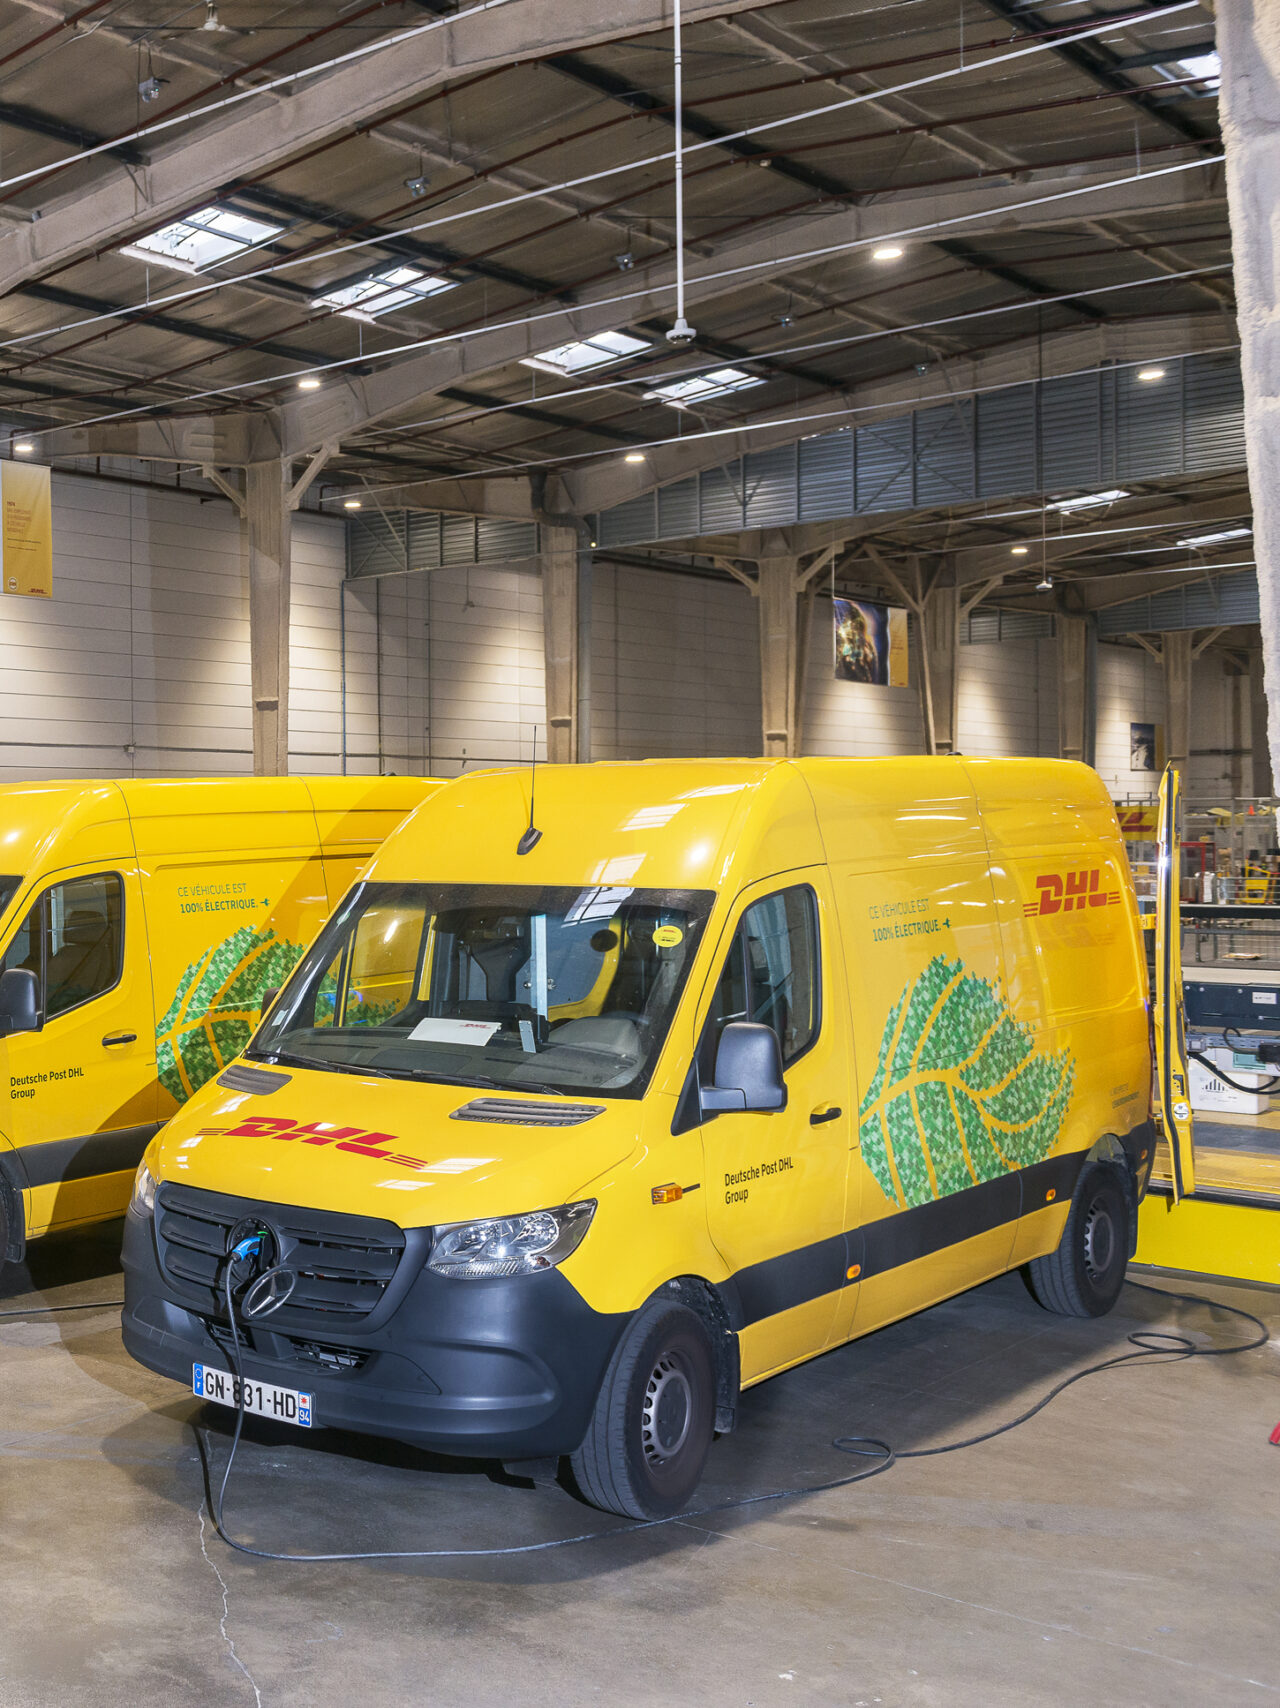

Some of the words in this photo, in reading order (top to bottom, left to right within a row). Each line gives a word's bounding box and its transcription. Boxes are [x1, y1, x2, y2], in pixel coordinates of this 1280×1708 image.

[177, 886, 189, 897] CE
[190, 883, 232, 897] VÉHICULE
[233, 882, 247, 894] EST
[1036, 869, 1108, 915] DHL
[180, 902, 204, 913] 100%
[205, 898, 258, 912] ÉLECTRIQUE.
[868, 905, 880, 919] CE
[916, 898, 930, 913] EST
[872, 925, 894, 942] 100%
[895, 919, 941, 939] ÉLECTRIQUE.
[10, 1073, 48, 1087] Deutsche
[49, 1070, 67, 1081] Post
[68, 1067, 85, 1078] DHL
[10, 1088, 35, 1099] Group
[221, 1116, 400, 1159] DHL
[724, 1166, 760, 1187] Deutsche
[761, 1160, 778, 1177] Post
[778, 1156, 794, 1172] DHL
[725, 1189, 749, 1205] Group
[205, 1371, 297, 1419] GN-831-HD
[299, 1410, 310, 1423] 94
